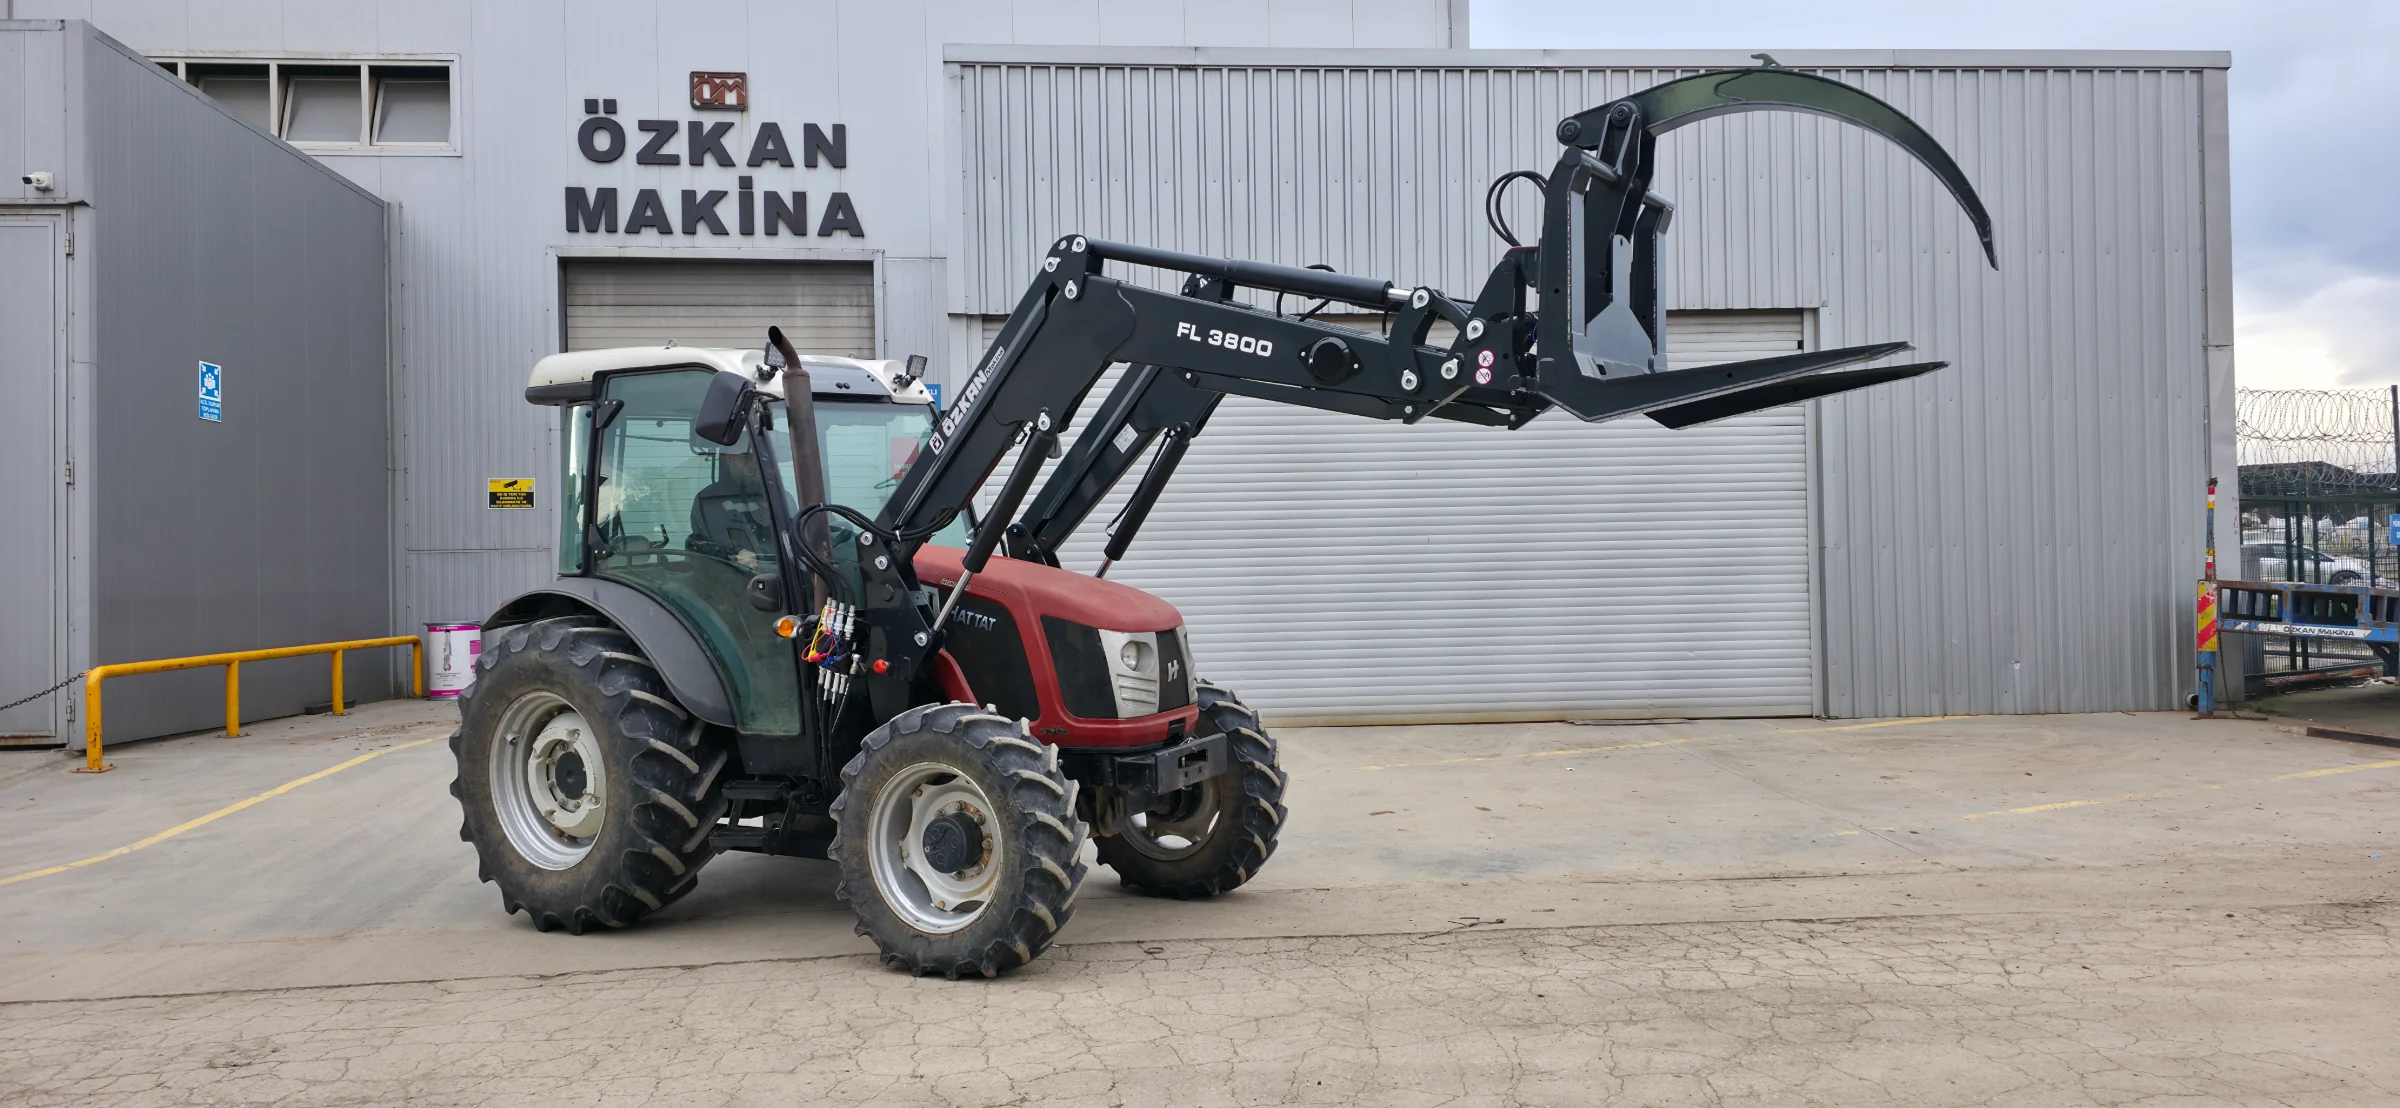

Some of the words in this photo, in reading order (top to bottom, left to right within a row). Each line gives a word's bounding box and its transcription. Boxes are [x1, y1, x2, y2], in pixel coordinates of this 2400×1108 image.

[577, 98, 847, 168] ÖZKAN
[565, 175, 865, 238] MAKİNA
[1176, 321, 1202, 342] FL
[1207, 329, 1273, 357] 3800
[942, 369, 988, 438] ÖZKAN
